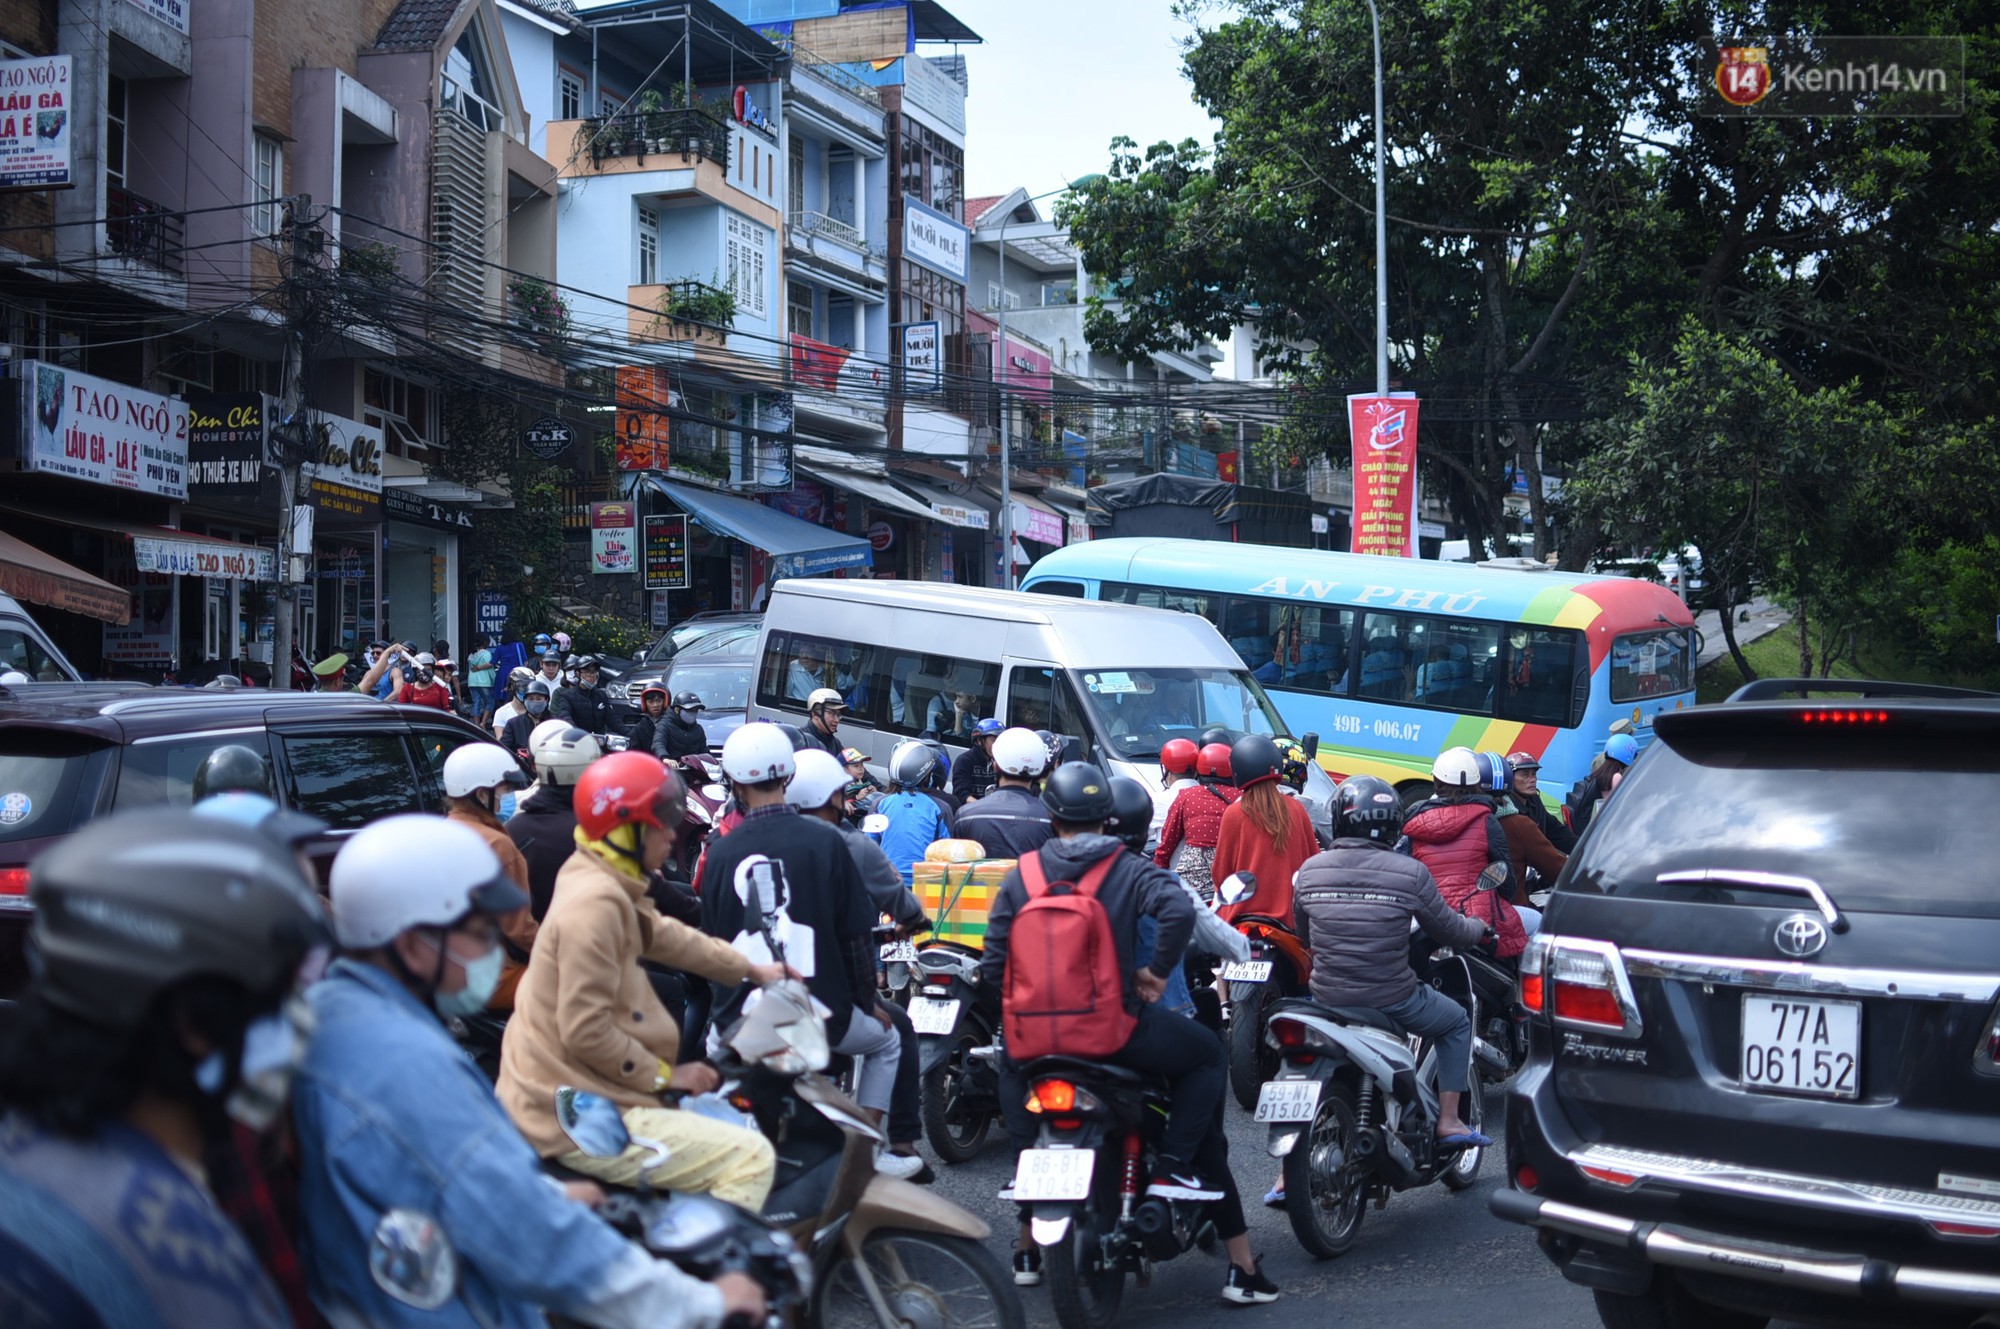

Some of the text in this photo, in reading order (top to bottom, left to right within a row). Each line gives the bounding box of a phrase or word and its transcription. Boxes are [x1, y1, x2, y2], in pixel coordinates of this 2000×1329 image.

[27, 60, 56, 89] NGỘ
[59, 65, 67, 83] 2
[38, 90, 63, 108] GÀ
[23, 113, 32, 136] É
[72, 385, 187, 442] TAO NGỘ 2
[227, 406, 260, 428] Chi
[65, 420, 87, 461] LẨU
[90, 432, 106, 465] GÀ
[116, 438, 129, 472] LÁ
[132, 440, 138, 473] É
[147, 463, 163, 481] PHÚ
[165, 467, 180, 485] YÊN
[202, 455, 226, 484] THUÊ
[227, 460, 240, 483] XE
[241, 454, 261, 483] MÁY
[1361, 461, 1382, 473] CHÀO
[387, 498, 404, 511] GUEST
[405, 503, 423, 515] HOUSE
[197, 553, 220, 573] TAO
[222, 552, 246, 579] NGỘ
[248, 558, 255, 575] 2
[1248, 576, 1488, 614] AN PHÚ
[481, 604, 507, 618] CHO
[1333, 713, 1361, 734] 49B
[1374, 718, 1422, 742] 006.07
[1364, 893, 1397, 902] OFF-WHITE
[1771, 1002, 1829, 1045] 77A
[1562, 1041, 1648, 1066] FORTUNER
[1746, 1044, 1855, 1092] 061.52
[1268, 1085, 1310, 1102] 59-N1
[1258, 1102, 1312, 1120] 915.02
